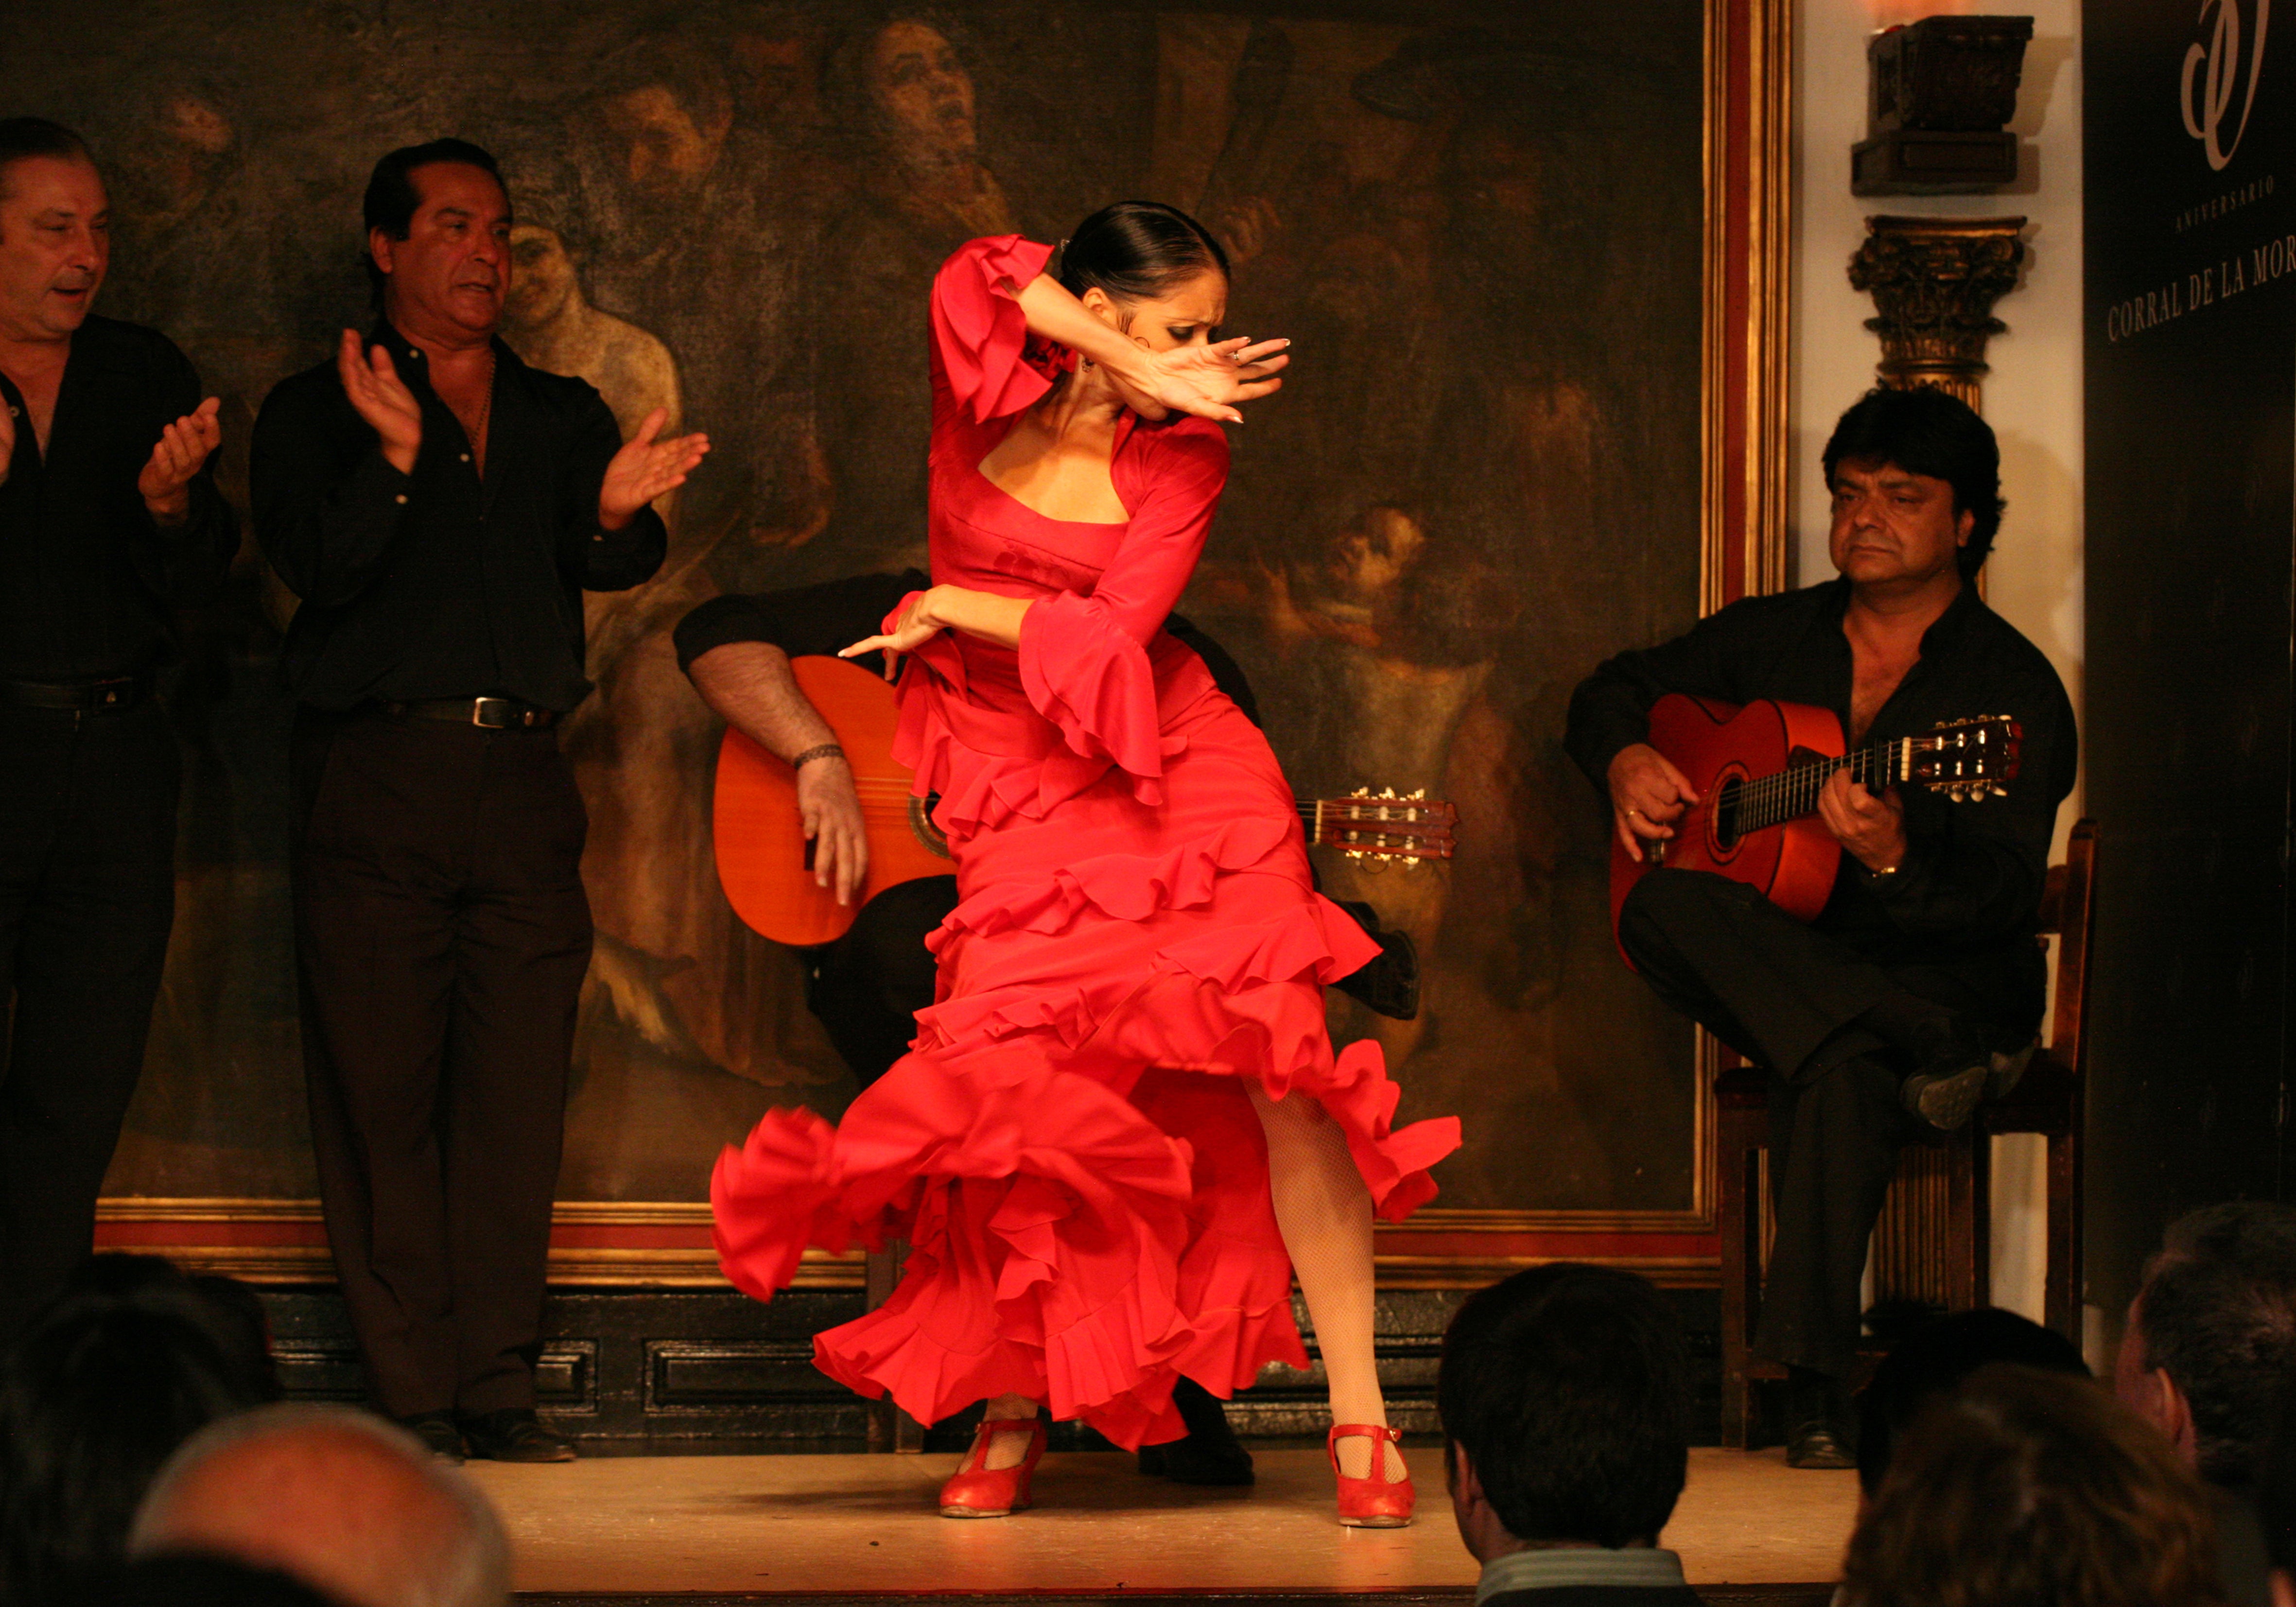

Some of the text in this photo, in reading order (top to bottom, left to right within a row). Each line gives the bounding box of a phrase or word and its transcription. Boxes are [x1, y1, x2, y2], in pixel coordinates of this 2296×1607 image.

[2176, 175, 2274, 234] ANIVERSARIO
[2108, 282, 2182, 342] CORRAL
[2189, 268, 2213, 311] DE
[2222, 256, 2245, 298] LA
